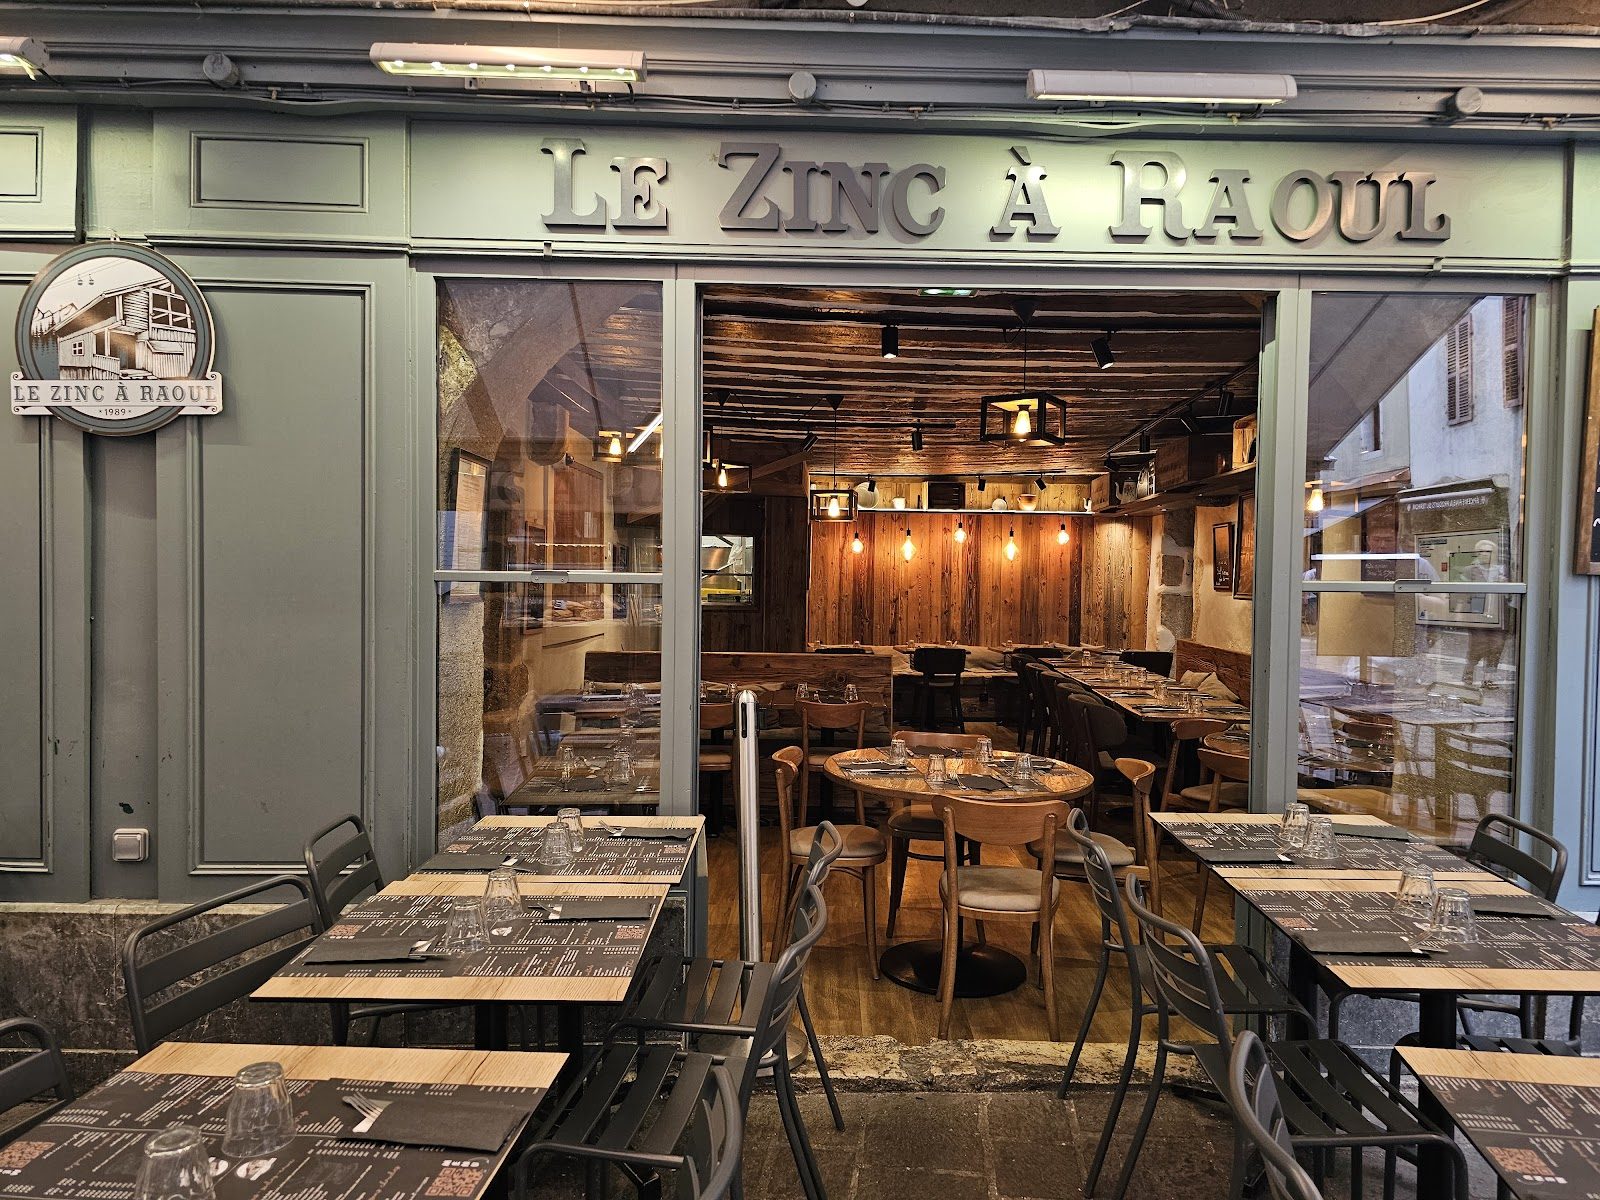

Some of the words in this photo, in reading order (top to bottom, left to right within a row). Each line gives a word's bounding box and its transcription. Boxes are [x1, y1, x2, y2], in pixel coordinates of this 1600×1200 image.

[541, 138, 668, 231] LE
[718, 142, 947, 236] ZINC
[990, 146, 1061, 241] À
[1109, 151, 1451, 243] RAOUL
[14, 385, 40, 402] LE
[50, 385, 105, 402] ZINC
[115, 382, 129, 402] À
[140, 385, 218, 402] RAOUL
[104, 408, 126, 416] 1989
